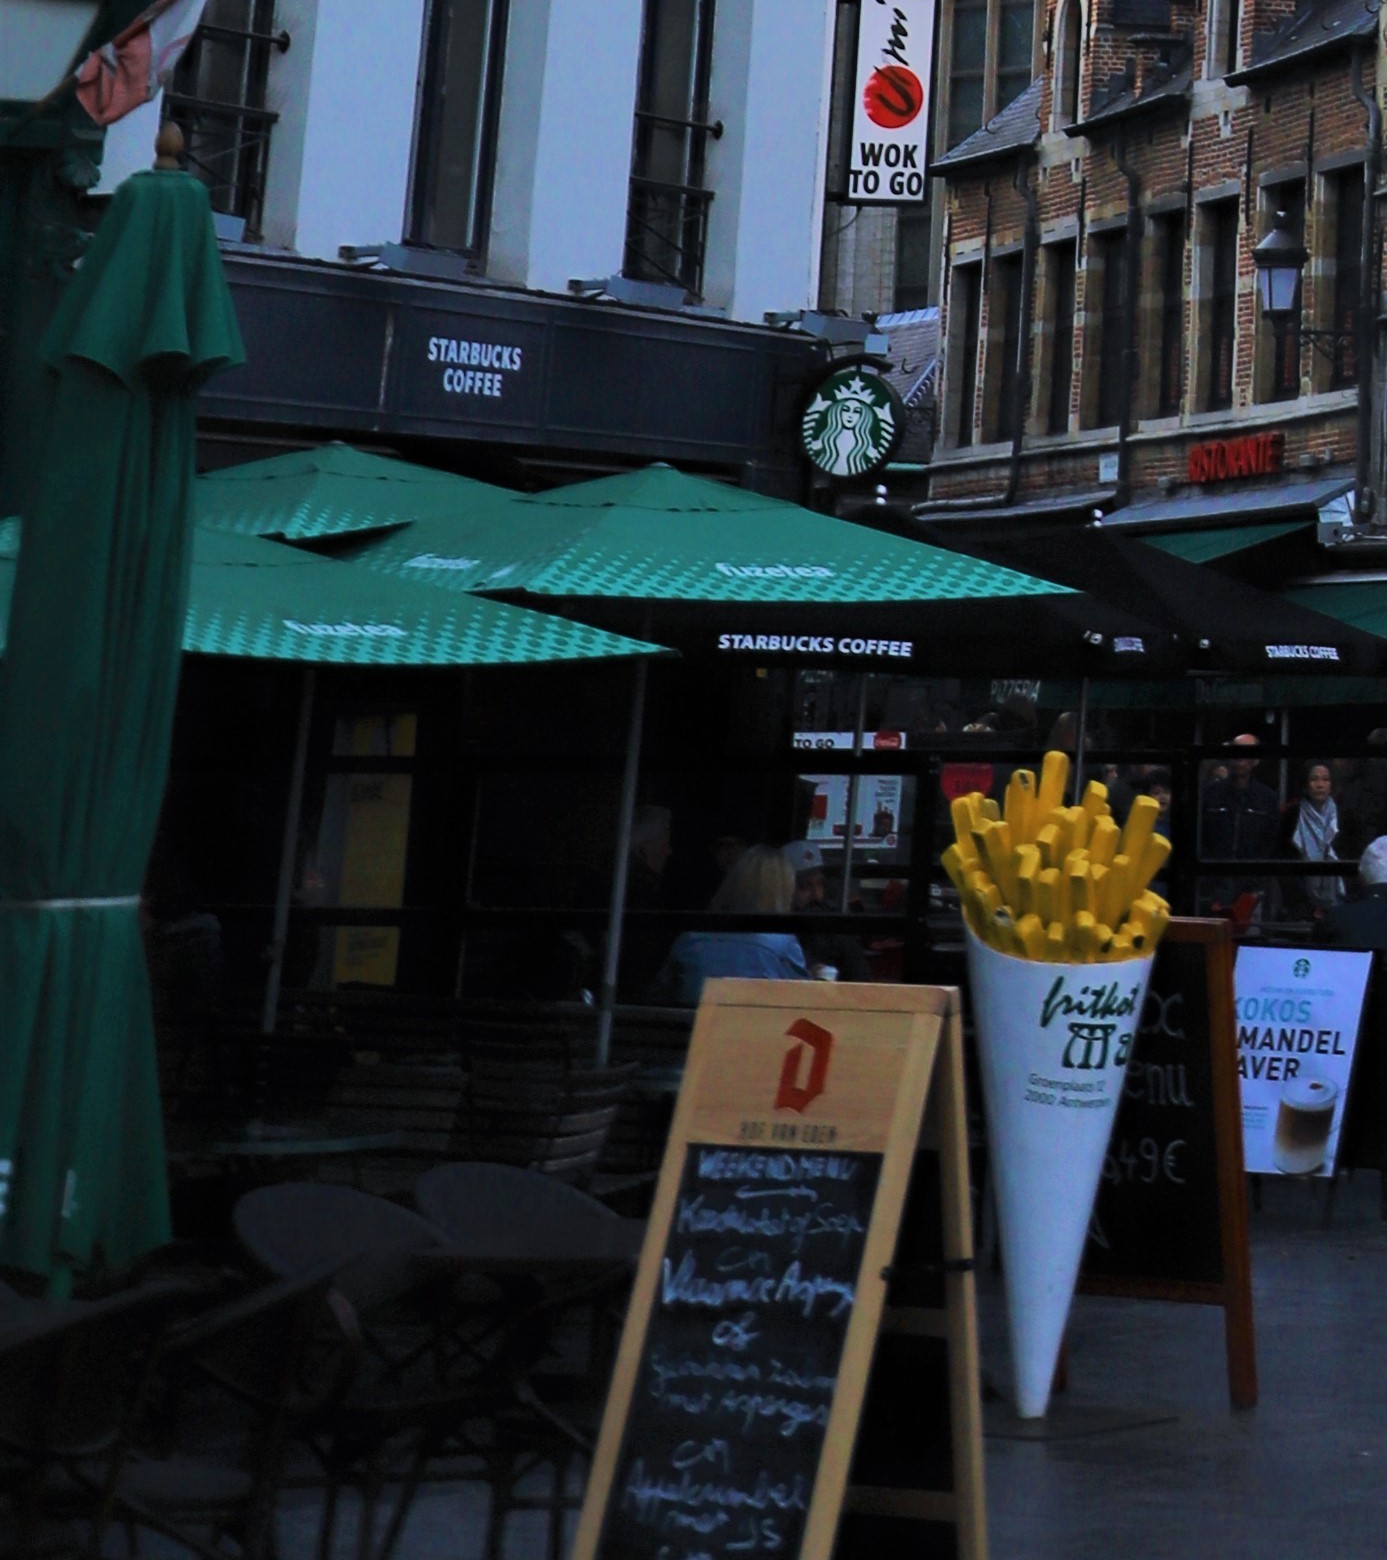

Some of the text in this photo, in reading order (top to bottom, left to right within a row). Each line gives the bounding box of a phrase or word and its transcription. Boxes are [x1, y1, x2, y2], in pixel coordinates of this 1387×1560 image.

[859, 142, 918, 169] WOK
[850, 169, 923, 197] TO GO
[427, 336, 522, 371] STARBUCKS
[443, 367, 503, 397] COFFEE
[715, 561, 836, 578] fuzetea
[718, 634, 914, 658] STARBUCKS COFFEE
[795, 738, 834, 749] TO GO
[1040, 976, 1141, 1028] fritkot
[1061, 1022, 1133, 1070] Ma
[1237, 1025, 1346, 1056] MANDEL
[1237, 1055, 1301, 1081] AVER
[1126, 1062, 1194, 1107] enu
[1102, 1137, 1188, 1186] ,49€
